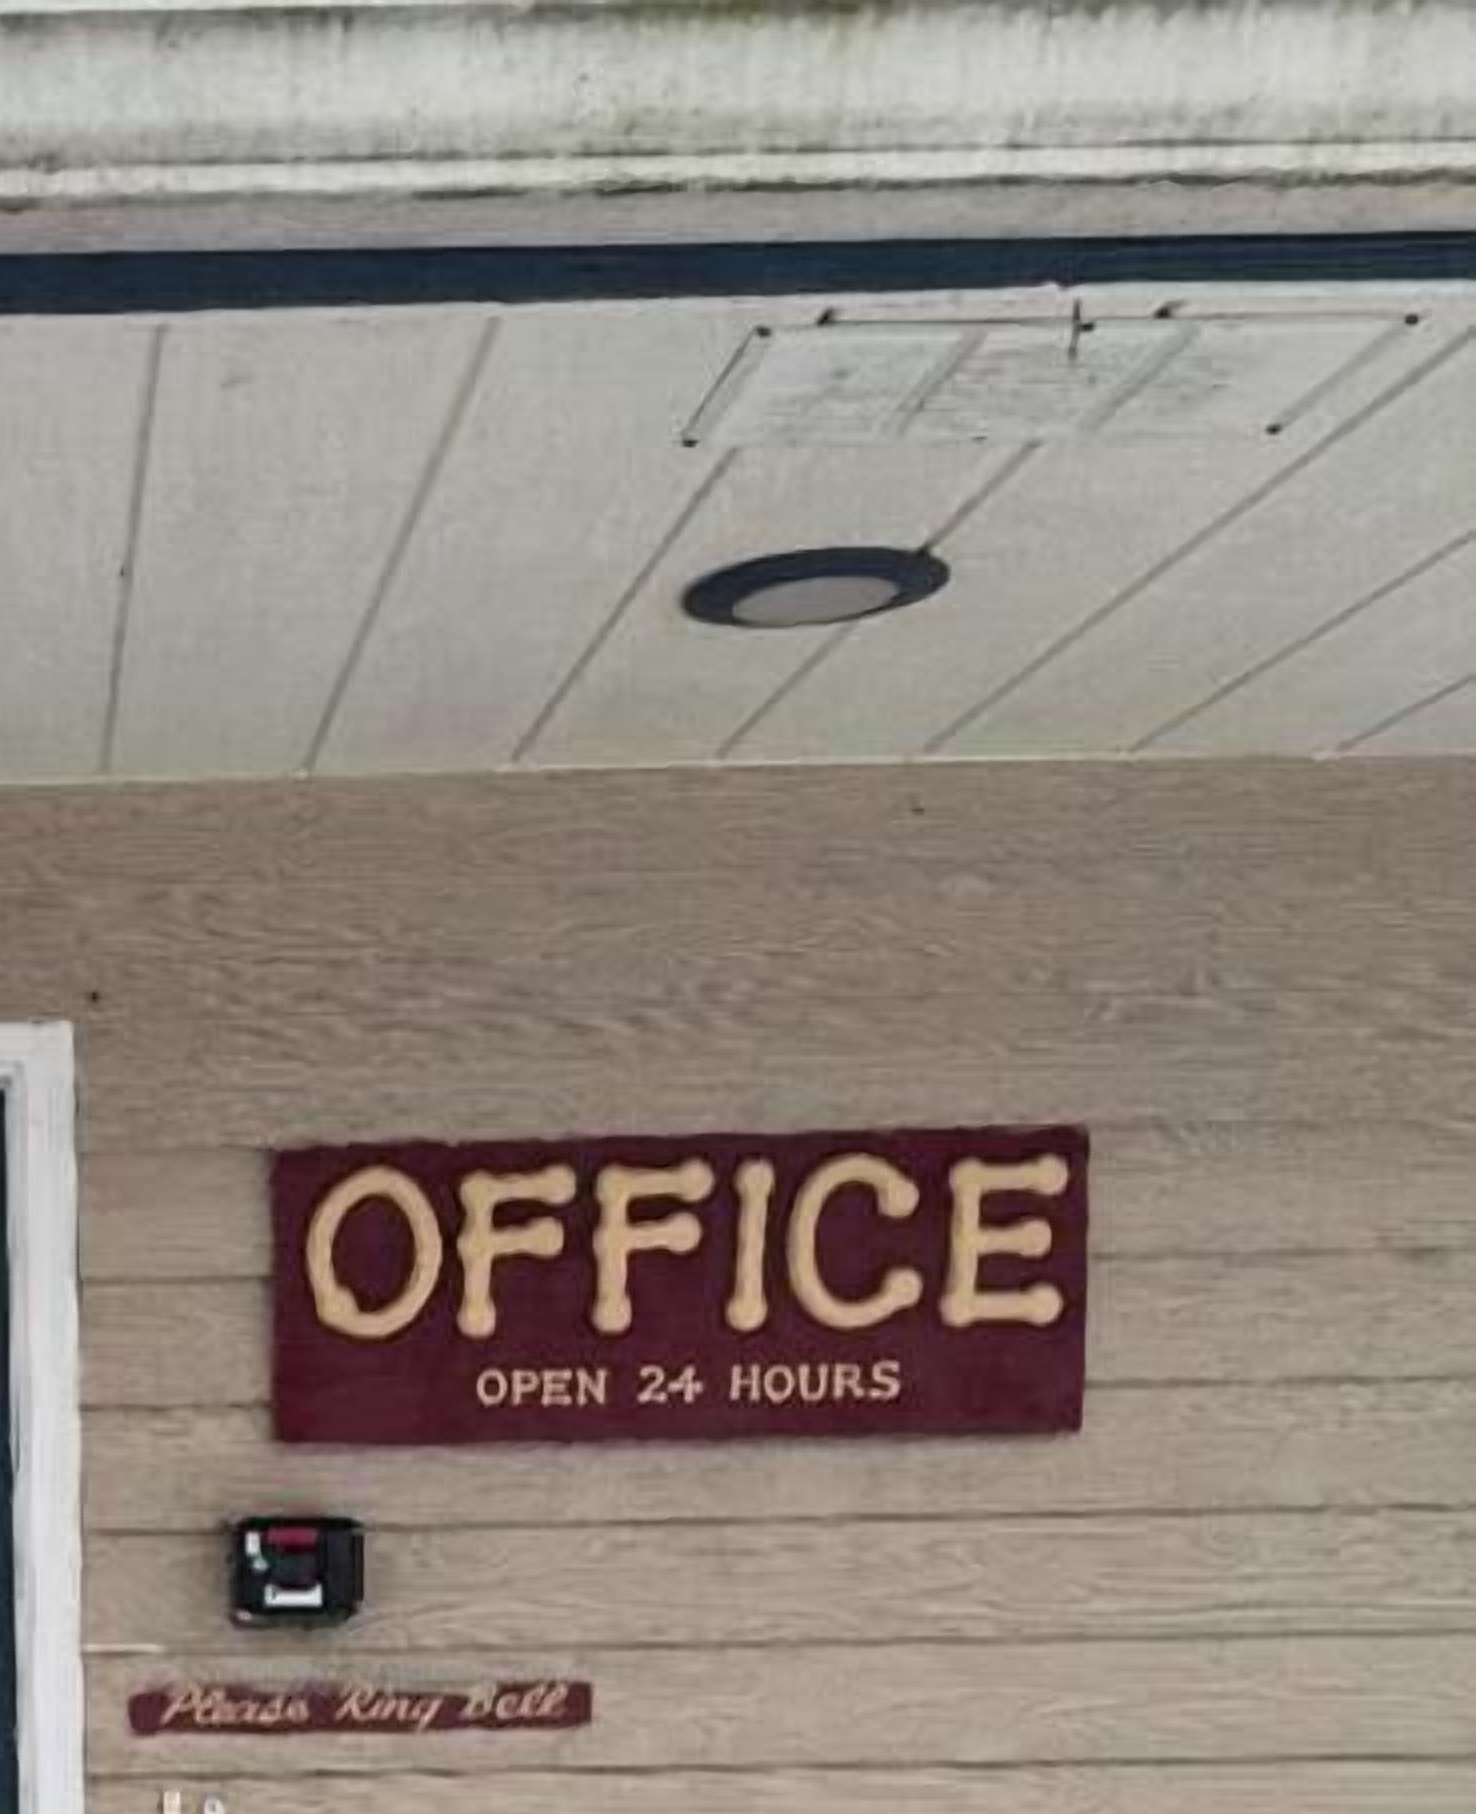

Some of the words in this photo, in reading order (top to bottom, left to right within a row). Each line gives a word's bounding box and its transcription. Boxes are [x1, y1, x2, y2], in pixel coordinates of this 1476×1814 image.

[305, 1152, 1069, 1339] OFFICE
[475, 1367, 608, 1406] OPEN
[636, 1363, 704, 1404] 24
[729, 1359, 902, 1402] HOURS
[160, 1680, 311, 1726] Please
[334, 1680, 445, 1732] Ring
[461, 1679, 571, 1721] Bell
